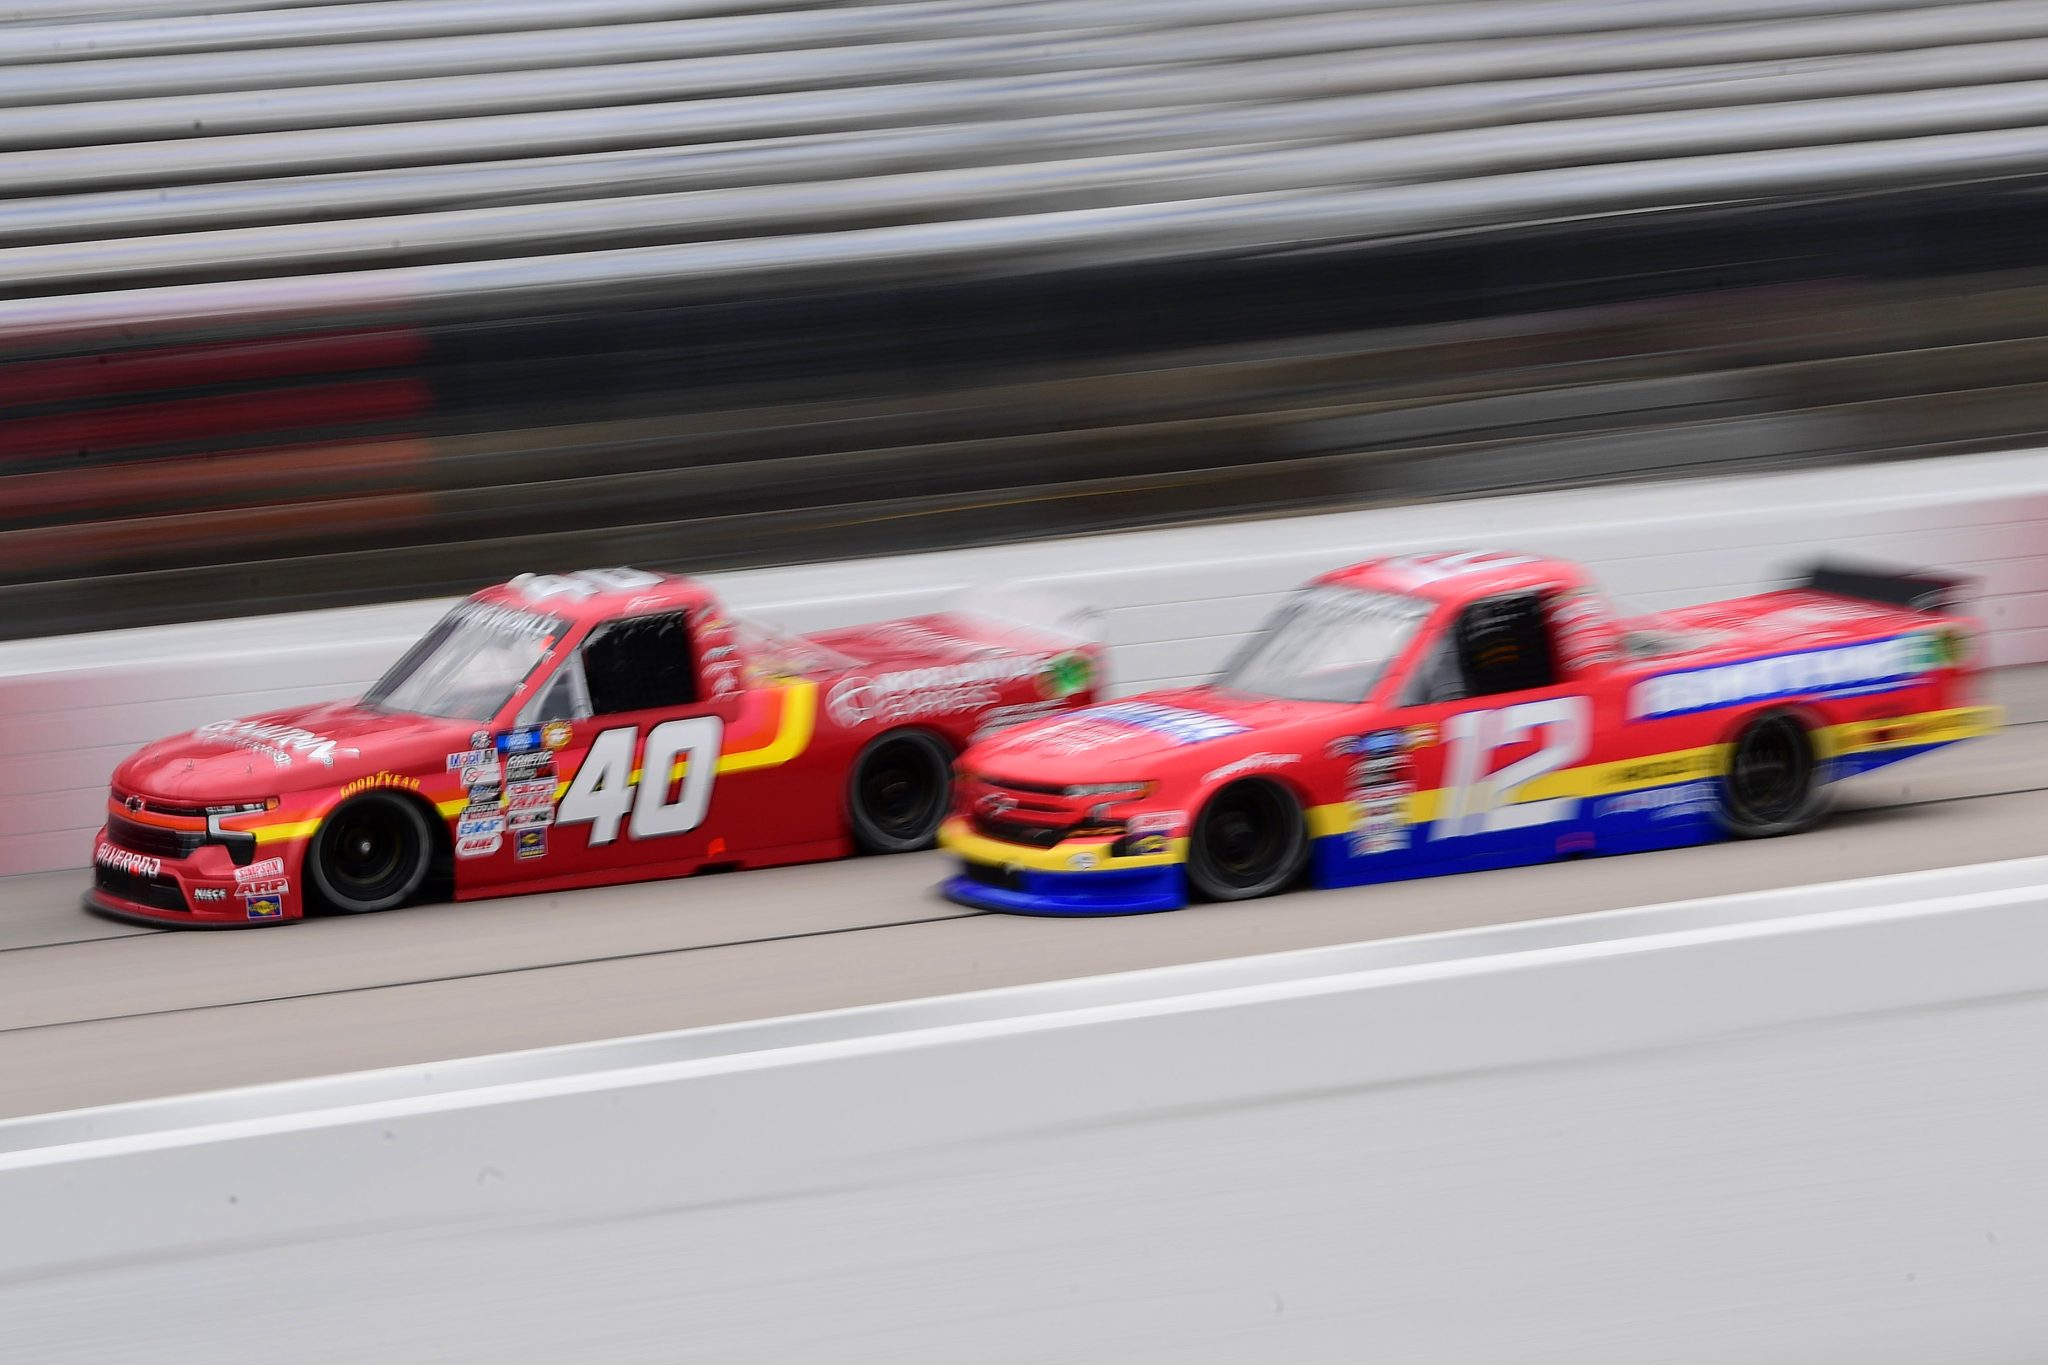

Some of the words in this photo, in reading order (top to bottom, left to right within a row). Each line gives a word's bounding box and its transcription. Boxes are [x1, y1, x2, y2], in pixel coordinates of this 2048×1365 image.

[450, 752, 482, 768] Mobil
[1426, 696, 1594, 843] 12
[340, 771, 420, 800] GOODYEAR
[554, 715, 724, 848] 40
[460, 820, 500, 836] SKF
[237, 880, 286, 895] ARP
